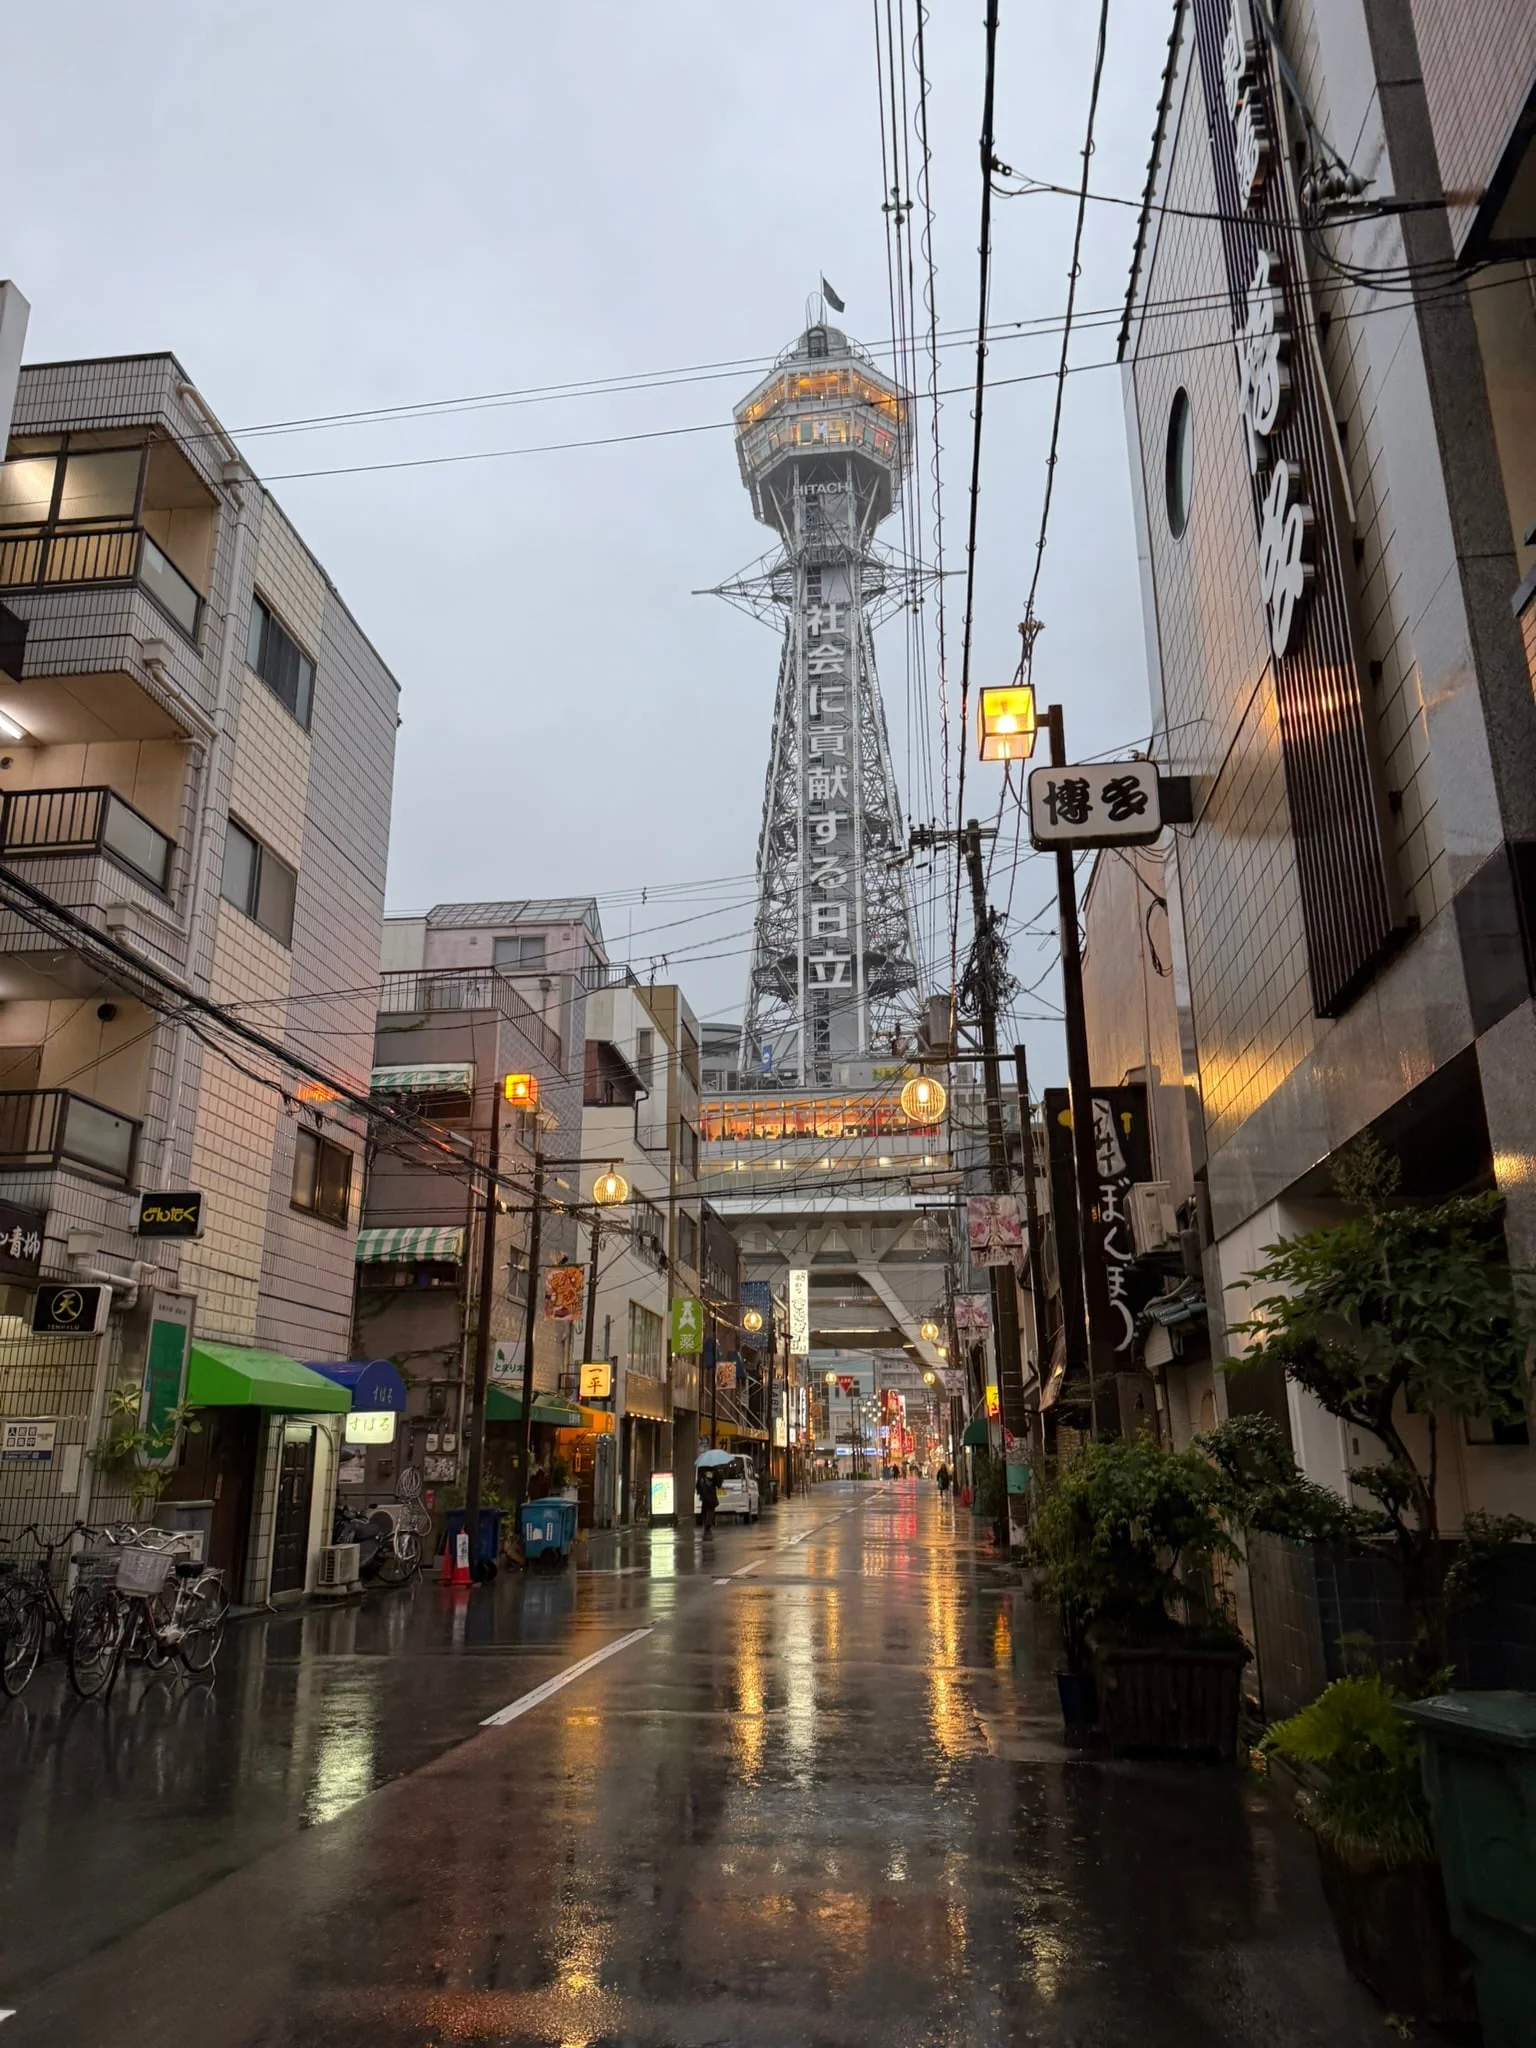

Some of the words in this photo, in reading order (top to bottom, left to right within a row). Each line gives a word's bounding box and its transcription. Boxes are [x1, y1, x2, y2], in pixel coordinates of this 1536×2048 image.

[793, 481, 854, 496] HITACHI
[807, 603, 852, 989] 社会に貢献する日立
[1042, 775, 1149, 826] 博多
[142, 1206, 198, 1222] どんたく
[54, 1293, 77, 1317] 天
[680, 1334, 695, 1350] 薬
[587, 1367, 603, 1394] 一平
